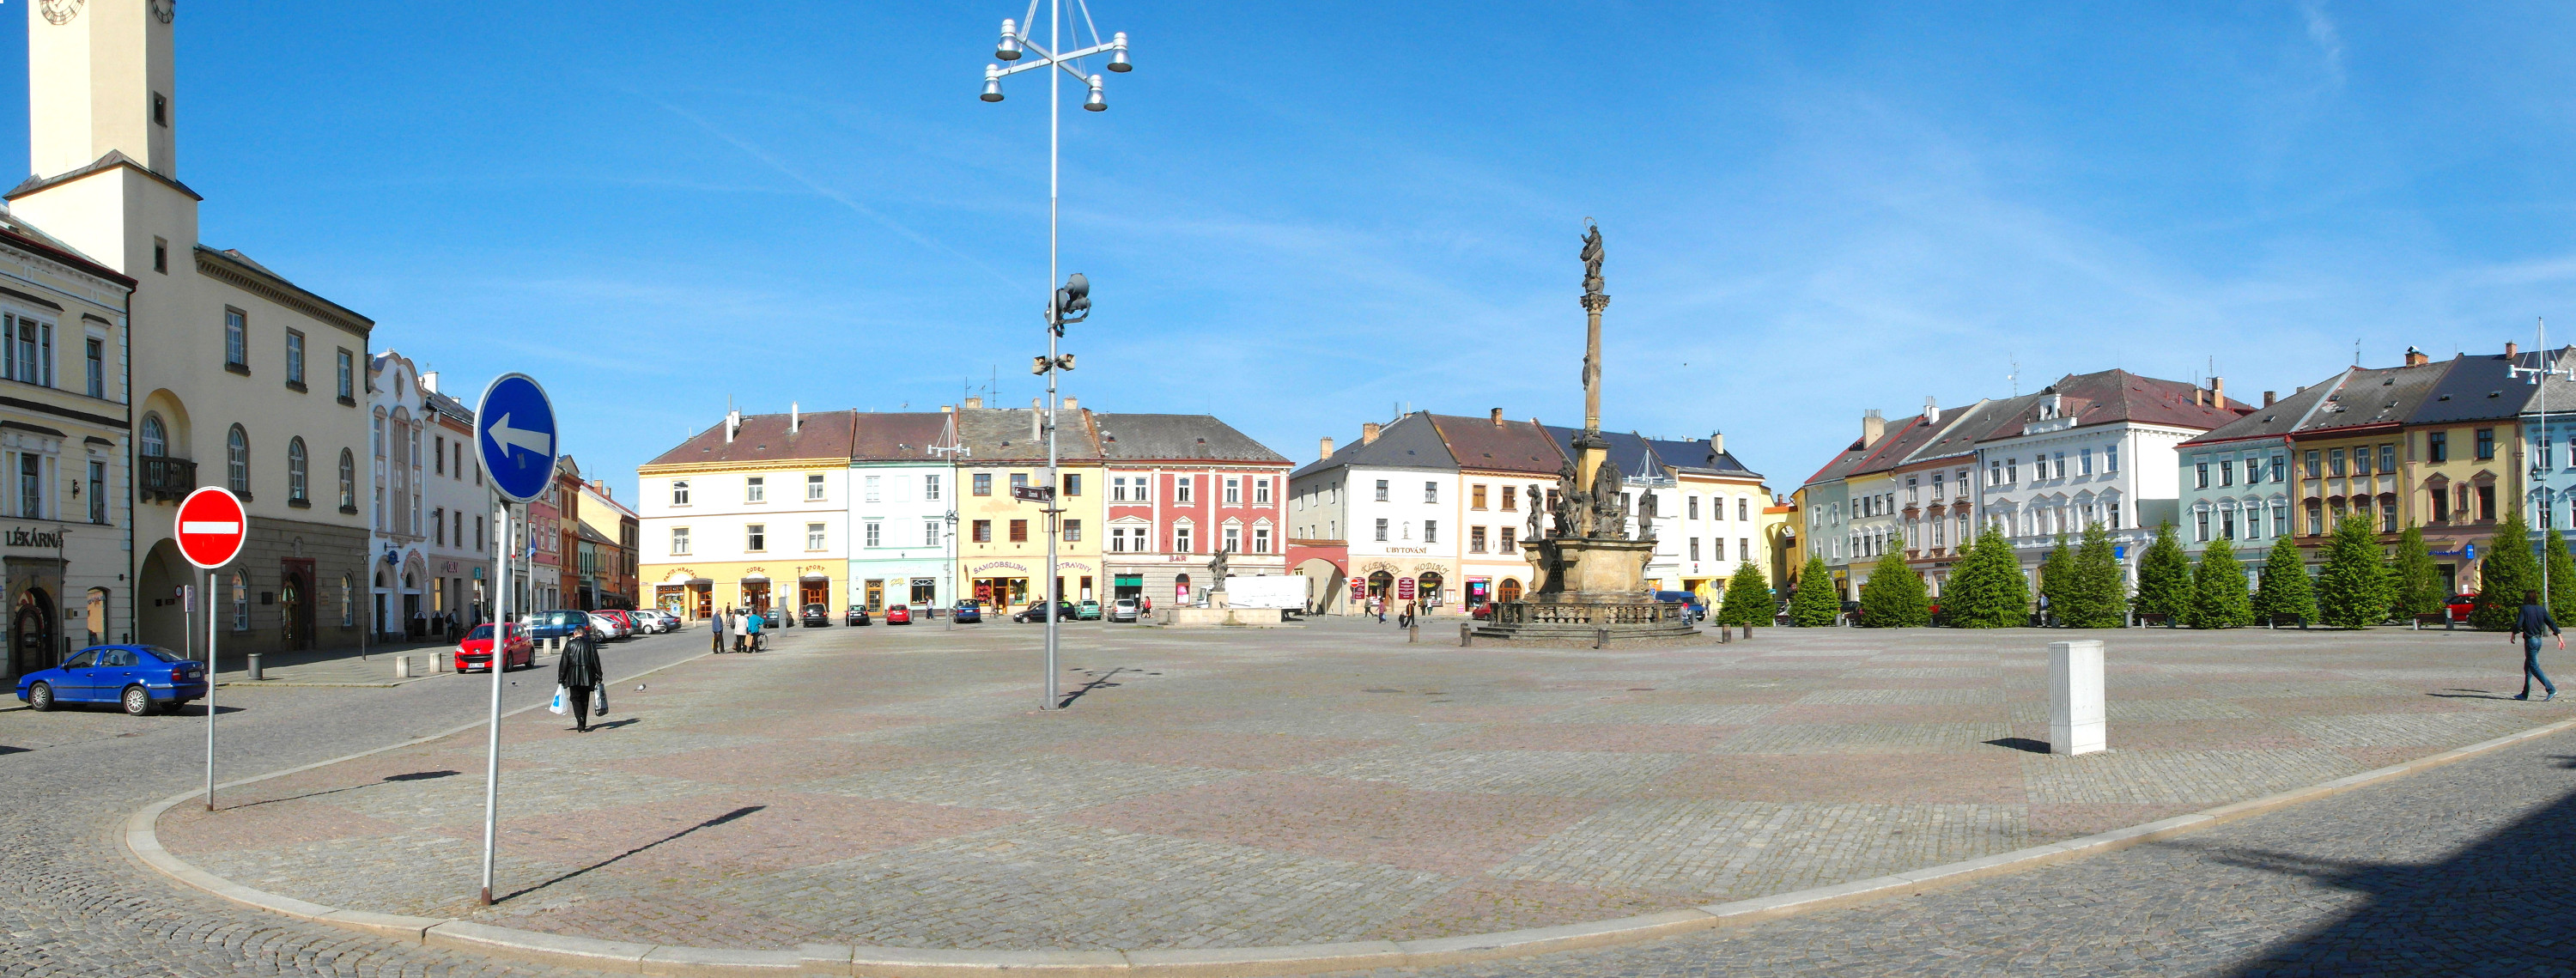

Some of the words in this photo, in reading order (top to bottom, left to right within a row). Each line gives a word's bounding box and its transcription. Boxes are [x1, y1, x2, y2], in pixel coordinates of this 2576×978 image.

[973, 562, 1028, 574] SAMOOBSLUHA
[1056, 562, 1092, 573] OTRAVINY
[1361, 561, 1401, 575] KLENOTY
[1413, 562, 1450, 575] HODINY
